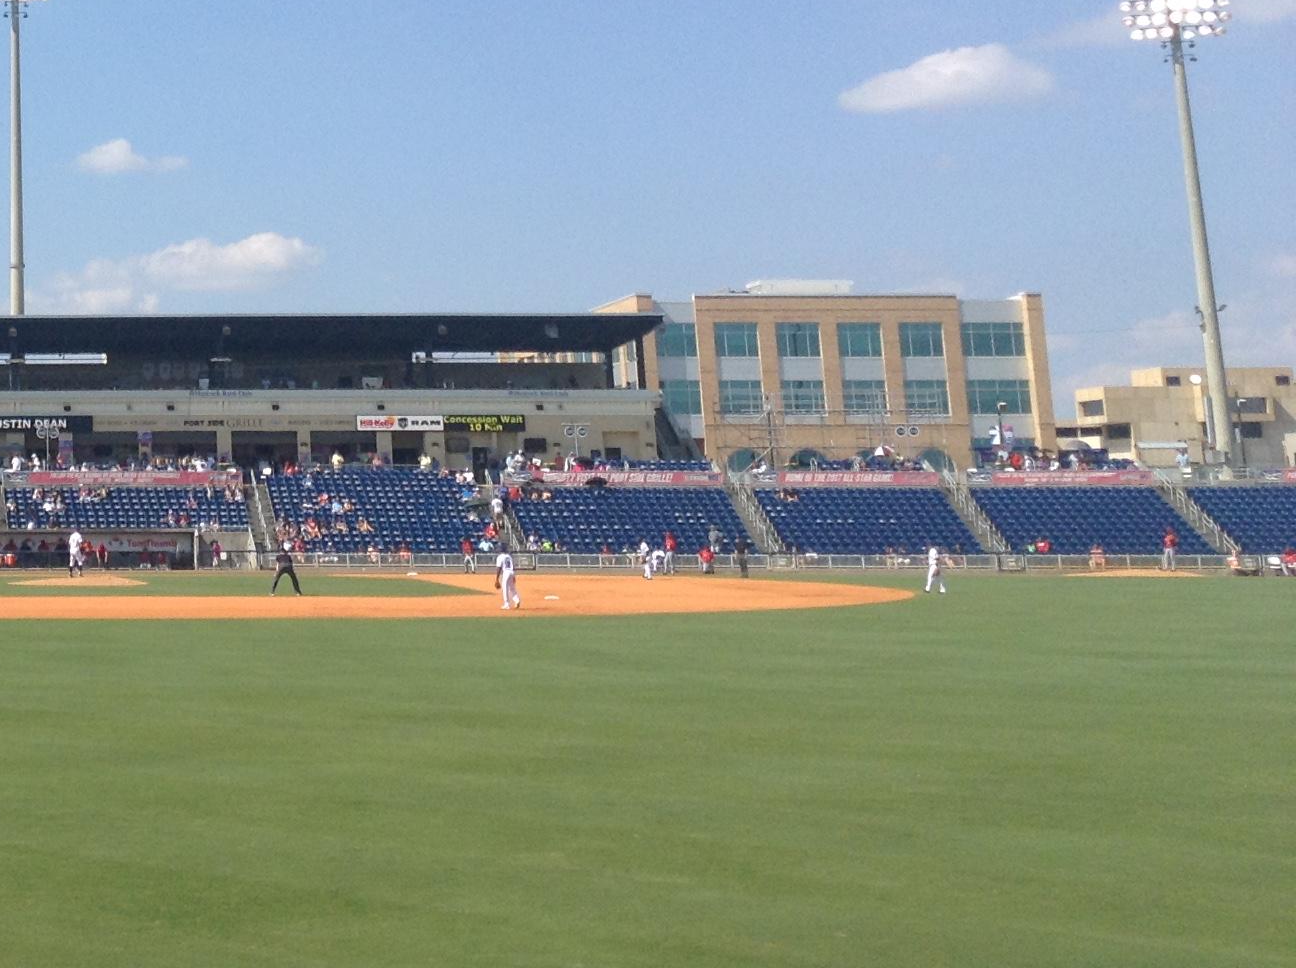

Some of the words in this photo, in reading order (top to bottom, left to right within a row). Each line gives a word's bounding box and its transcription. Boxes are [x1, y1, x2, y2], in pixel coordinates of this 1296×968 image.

[35, 419, 67, 429] DEAN
[443, 415, 499, 424] Concession
[501, 415, 523, 424] Wait
[469, 424, 480, 432] 10
